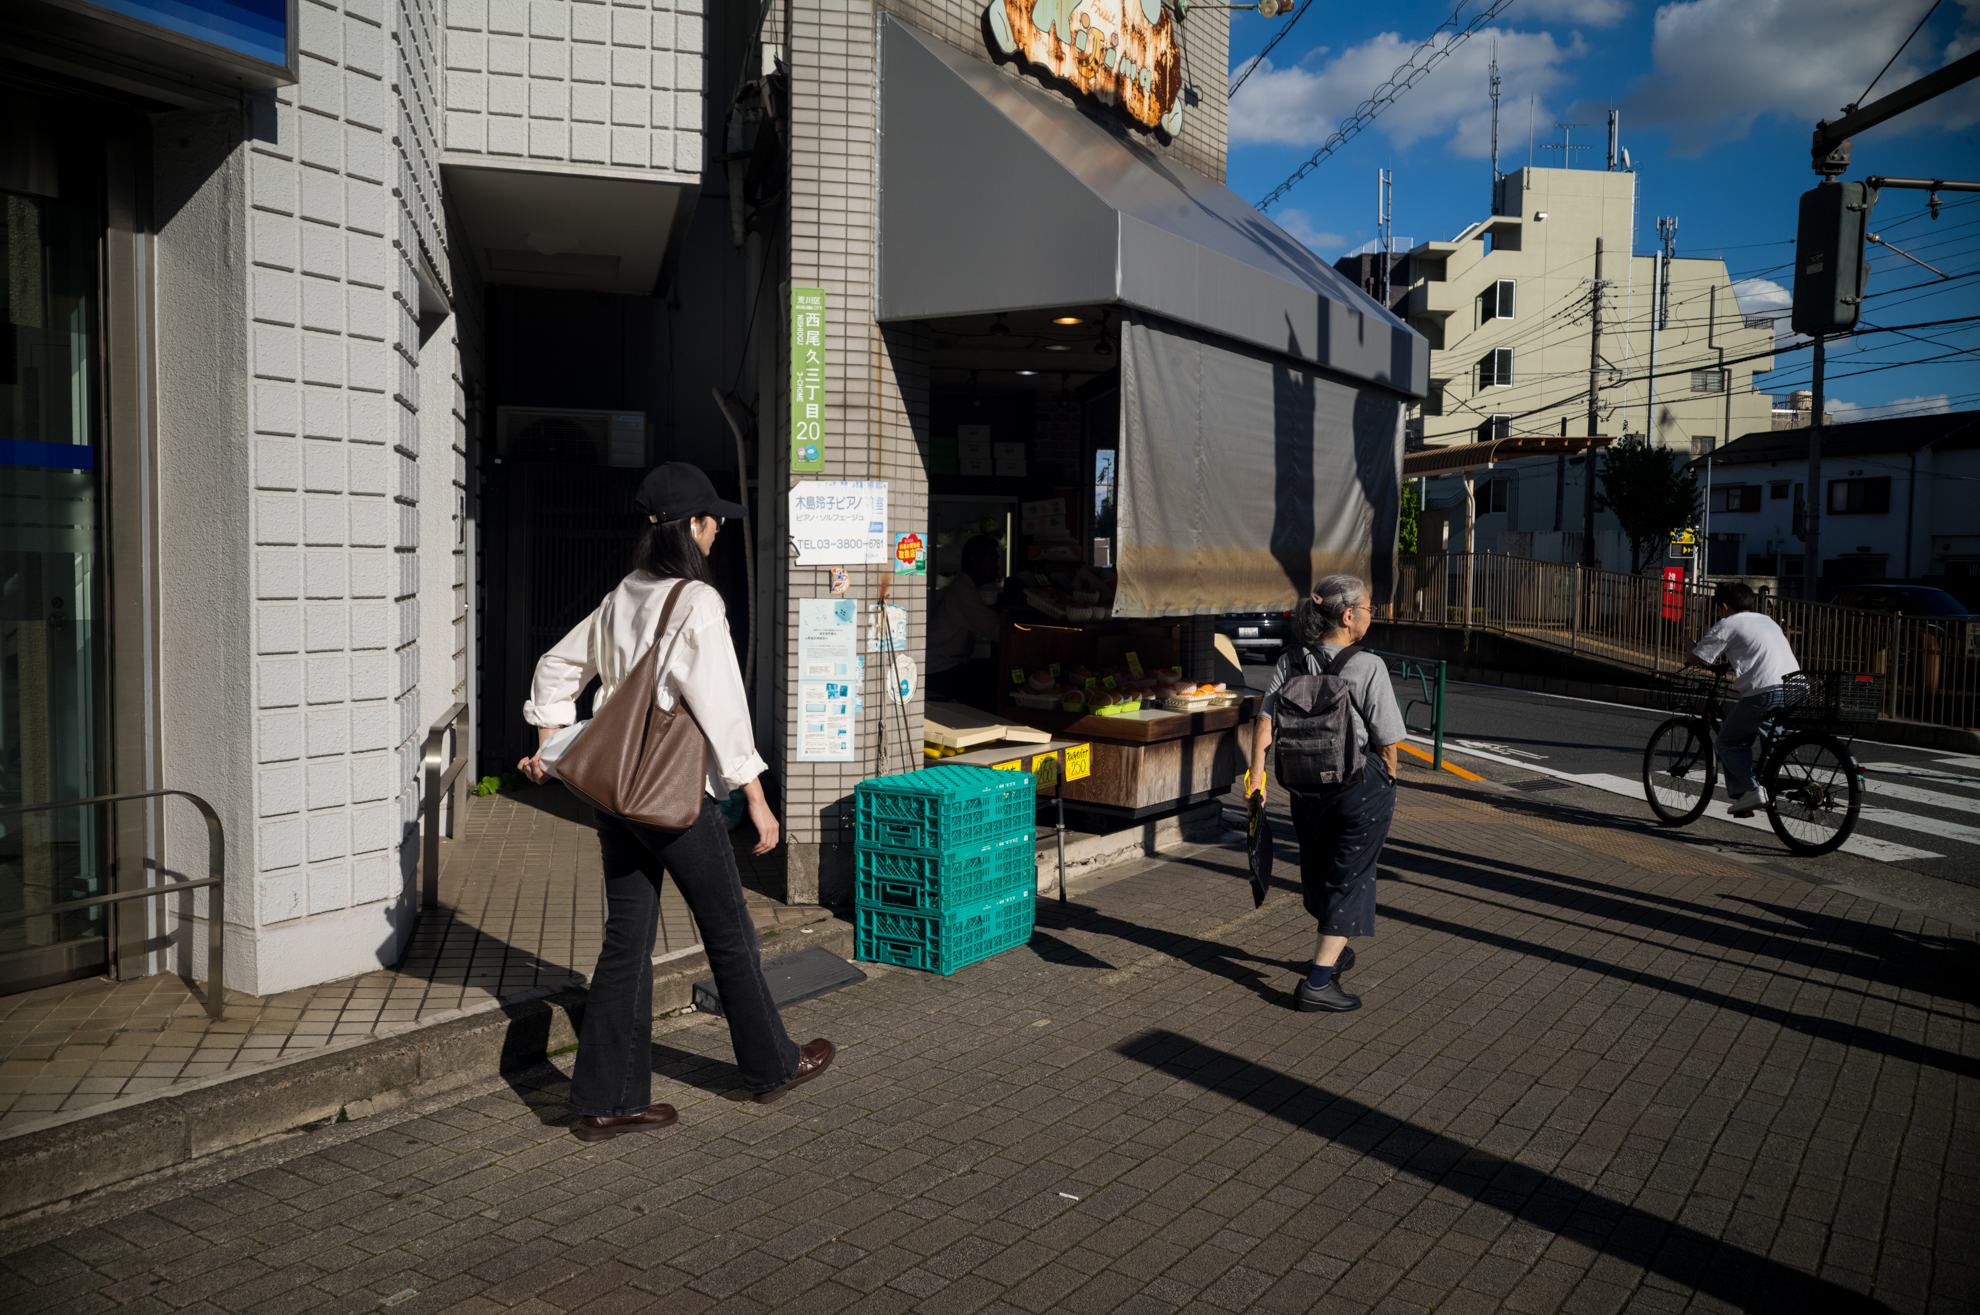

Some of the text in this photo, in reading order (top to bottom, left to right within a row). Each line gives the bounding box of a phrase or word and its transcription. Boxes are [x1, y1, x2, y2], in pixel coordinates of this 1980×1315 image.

[1090, 0, 1117, 26] Fruit
[797, 296, 821, 304] 荒川区
[796, 314, 804, 403] NISHIOGU 3-CHOME
[805, 312, 821, 419] 西尾久三丁目
[796, 421, 820, 440] 20
[796, 513, 865, 521] ピアノ・ソルフェージュ
[898, 549, 916, 559] 取扱店
[1037, 767, 1053, 785] 200
[1071, 759, 1087, 776] 250
